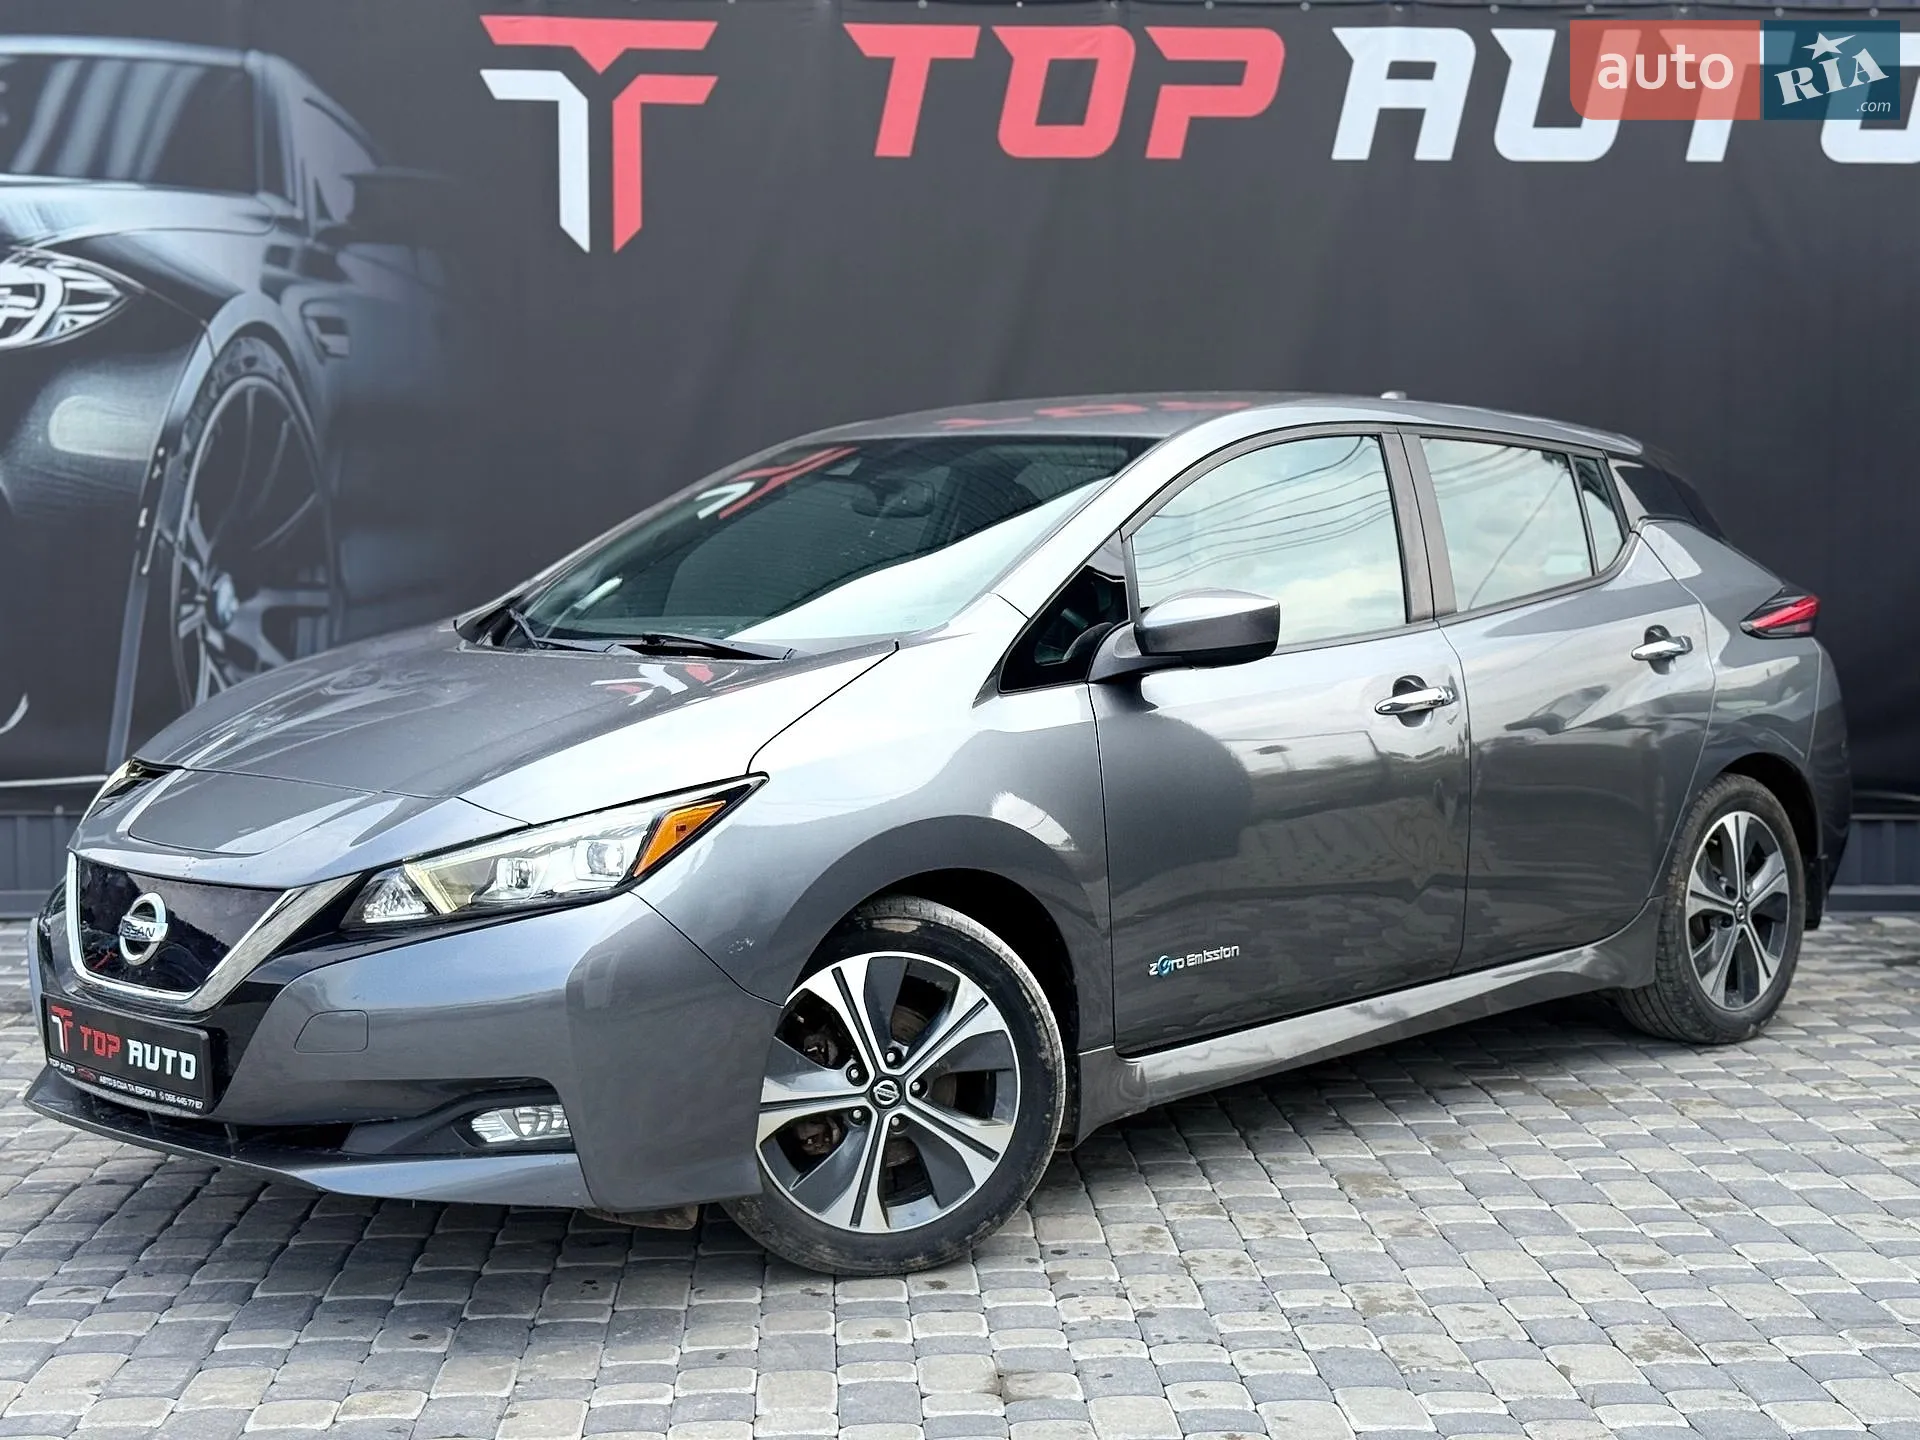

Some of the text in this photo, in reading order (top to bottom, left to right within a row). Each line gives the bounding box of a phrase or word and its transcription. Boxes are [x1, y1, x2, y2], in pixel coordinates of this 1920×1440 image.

[842, 23, 1920, 163] TOP AUTO
[121, 920, 156, 938] SSAN
[79, 1025, 197, 1081] TOP AUTO
